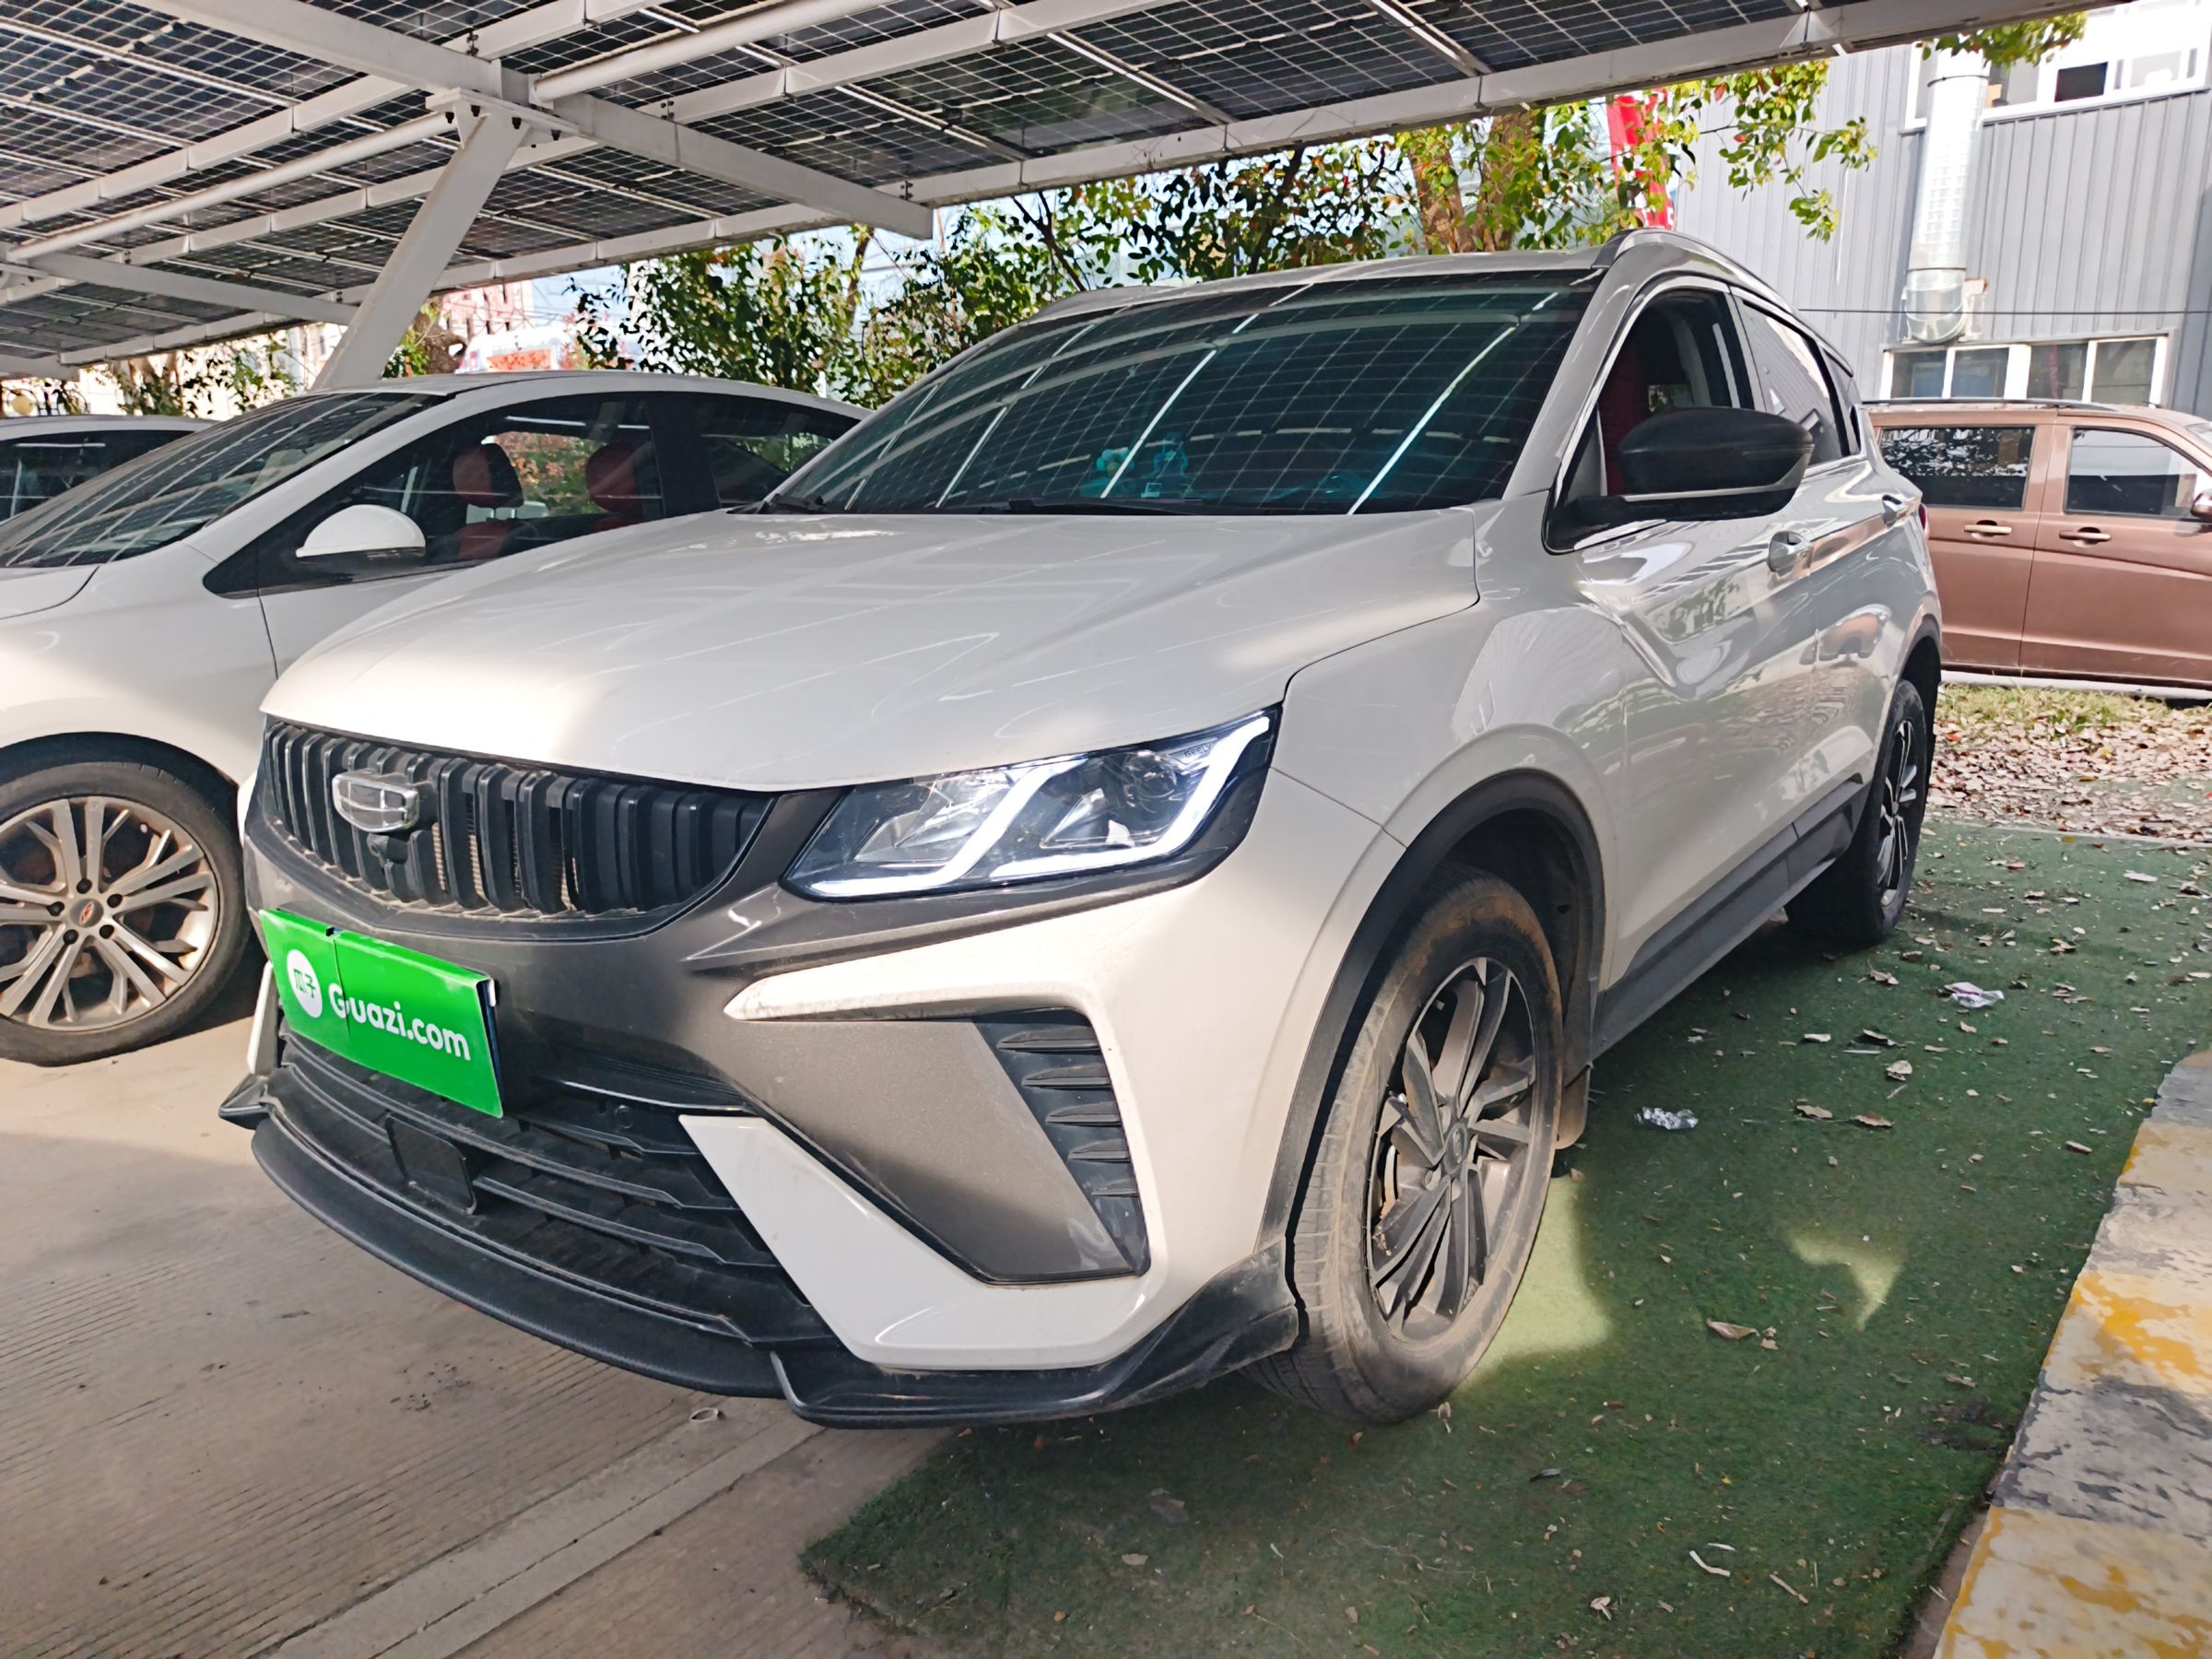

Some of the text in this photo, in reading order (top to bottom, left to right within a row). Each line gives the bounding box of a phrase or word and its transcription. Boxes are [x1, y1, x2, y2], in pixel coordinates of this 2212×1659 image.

[1184, 743, 1213, 758] GEELY
[292, 968, 316, 999] 瓜子
[328, 982, 471, 1061] Guazi.com
